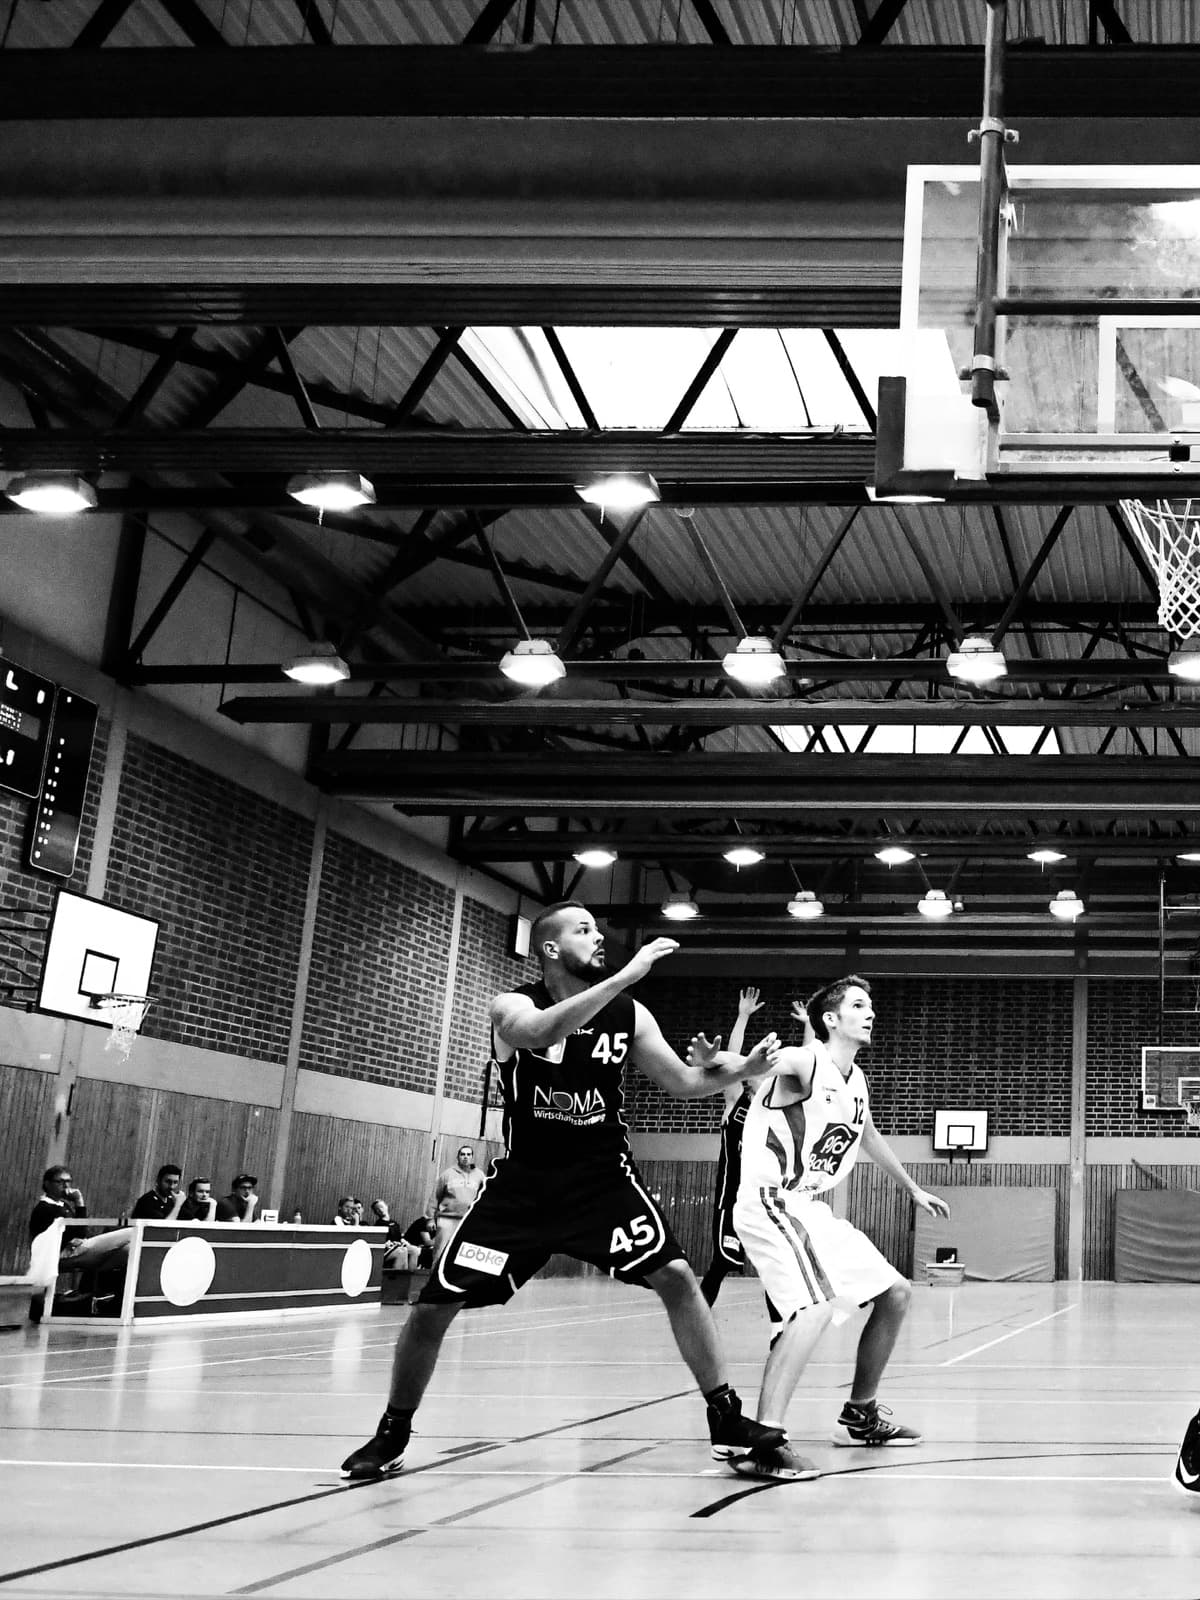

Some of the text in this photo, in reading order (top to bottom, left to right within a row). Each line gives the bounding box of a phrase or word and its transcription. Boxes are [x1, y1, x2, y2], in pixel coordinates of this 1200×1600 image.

[591, 1032, 628, 1064] 45
[533, 1085, 606, 1114] NOMA
[852, 1096, 864, 1125] 12
[809, 1153, 838, 1174] Bank
[609, 1215, 655, 1253] 45
